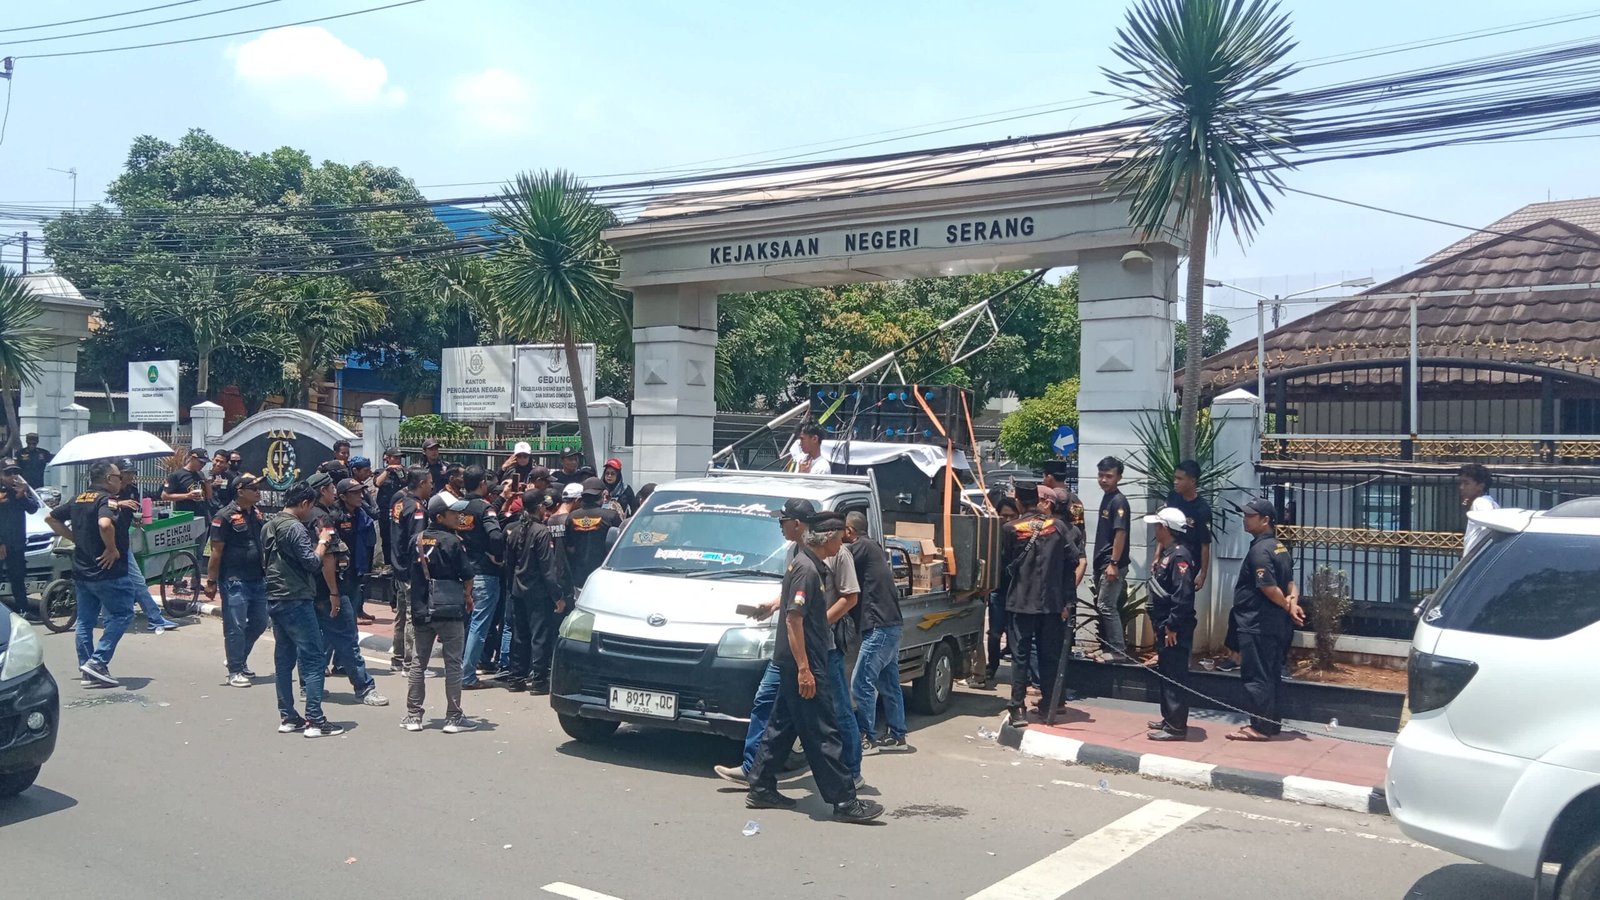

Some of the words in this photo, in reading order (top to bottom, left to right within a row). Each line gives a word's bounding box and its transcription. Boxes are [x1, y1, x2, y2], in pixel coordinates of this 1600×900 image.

[710, 237, 819, 265] KEJAKSAAN
[845, 227, 919, 252] NEGERI
[946, 215, 1035, 244] SERANG
[538, 376, 571, 384] GEDUNG
[155, 533, 165, 546] ES
[167, 533, 193, 547] CENDOL
[612, 690, 619, 703] A
[626, 691, 652, 707] 8917
[659, 696, 673, 709] QC
